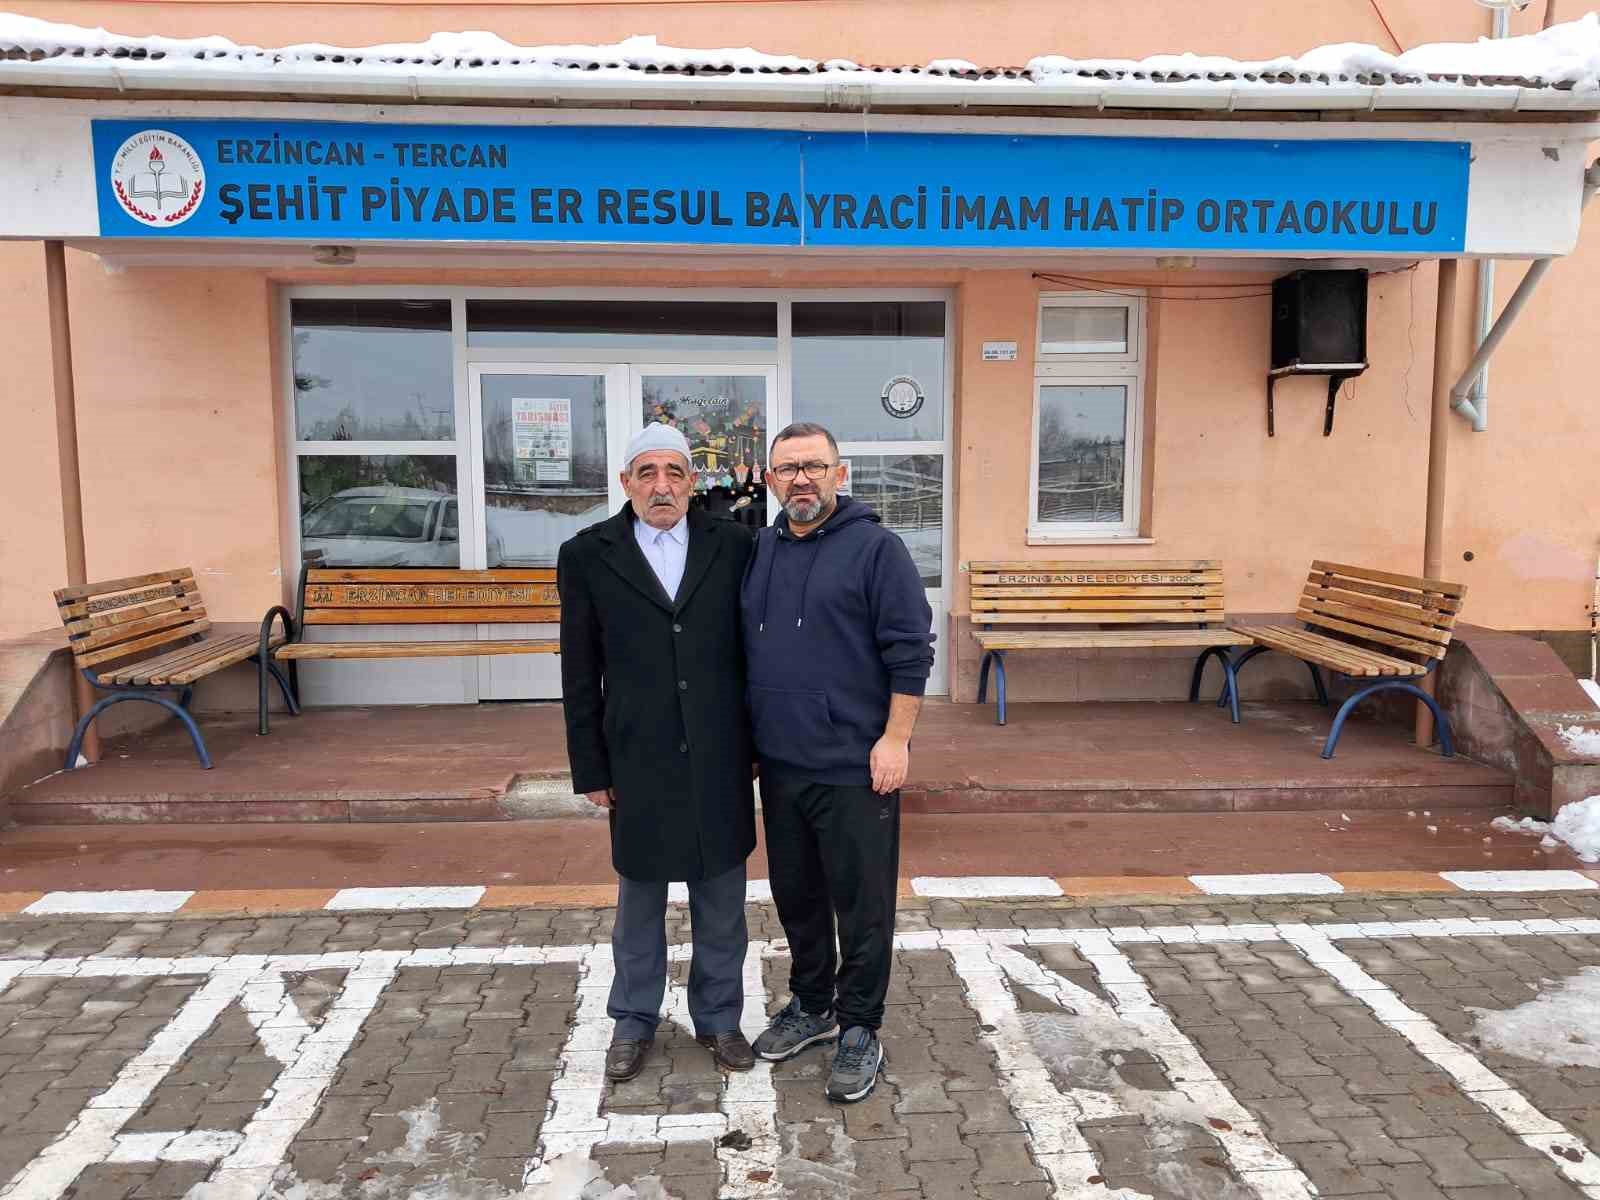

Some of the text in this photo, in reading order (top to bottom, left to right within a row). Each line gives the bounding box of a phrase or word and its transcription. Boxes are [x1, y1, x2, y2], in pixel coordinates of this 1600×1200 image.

[216, 132, 508, 169] ERZİNCAN - TERCAN
[218, 175, 1439, 236] ŞEHİT PİYADE ER RESUL BAYRACİ İMAM HATİP ORTAOKULU
